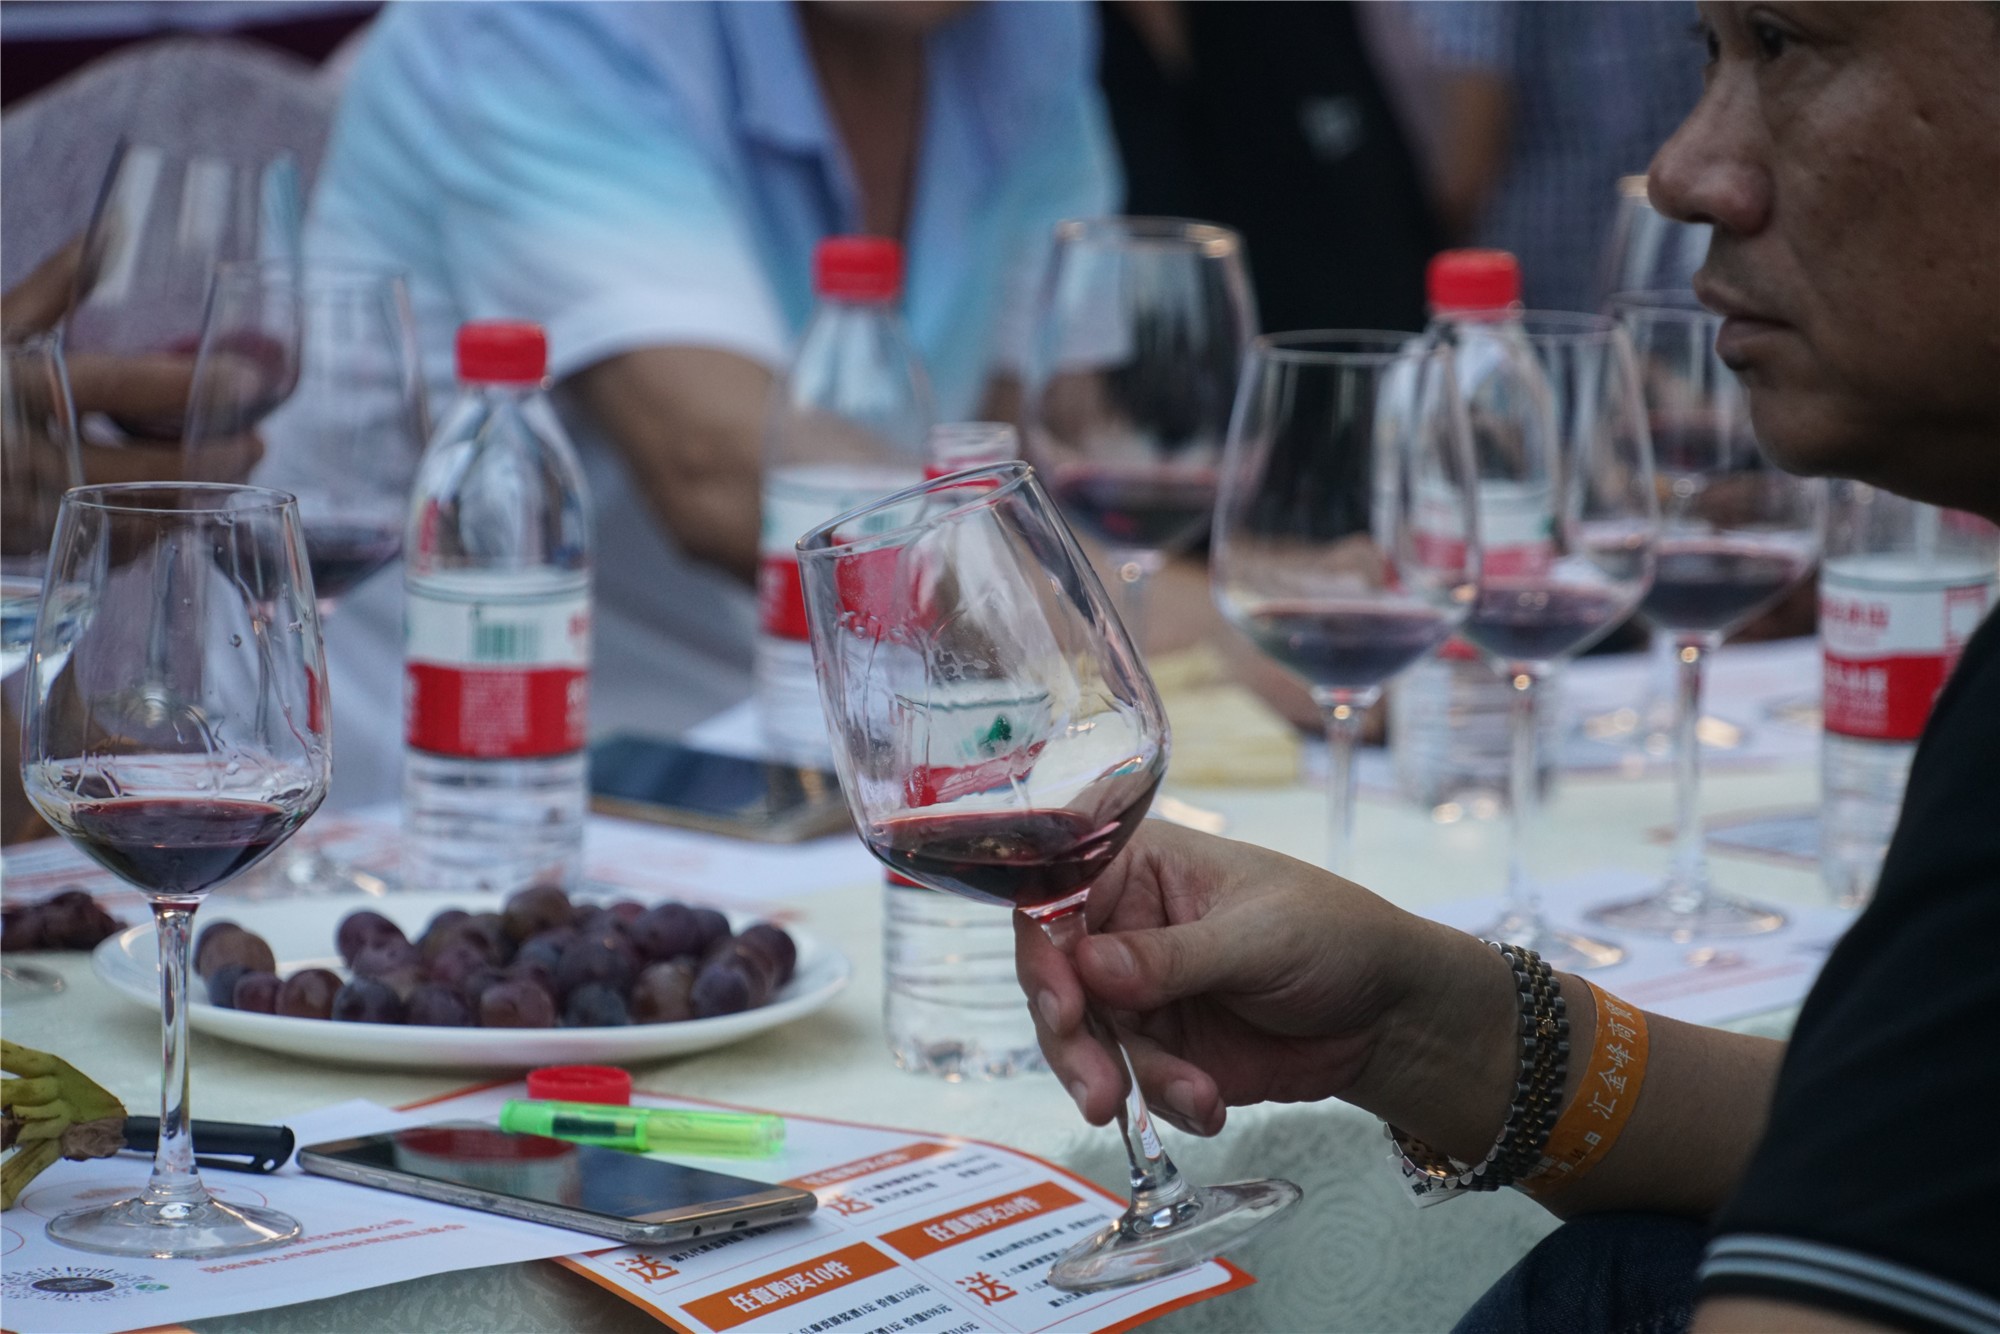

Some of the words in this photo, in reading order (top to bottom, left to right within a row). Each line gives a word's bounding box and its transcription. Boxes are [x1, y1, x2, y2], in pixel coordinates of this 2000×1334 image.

[923, 1195, 1043, 1242] 任意购买20件
[615, 1253, 680, 1284] 送
[728, 1260, 853, 1313] 任意购买10件
[875, 1283, 931, 1309] 价值1260元
[955, 1271, 1018, 1306] 送
[903, 1303, 953, 1327] 价值898元
[941, 1321, 980, 1334] 316元
